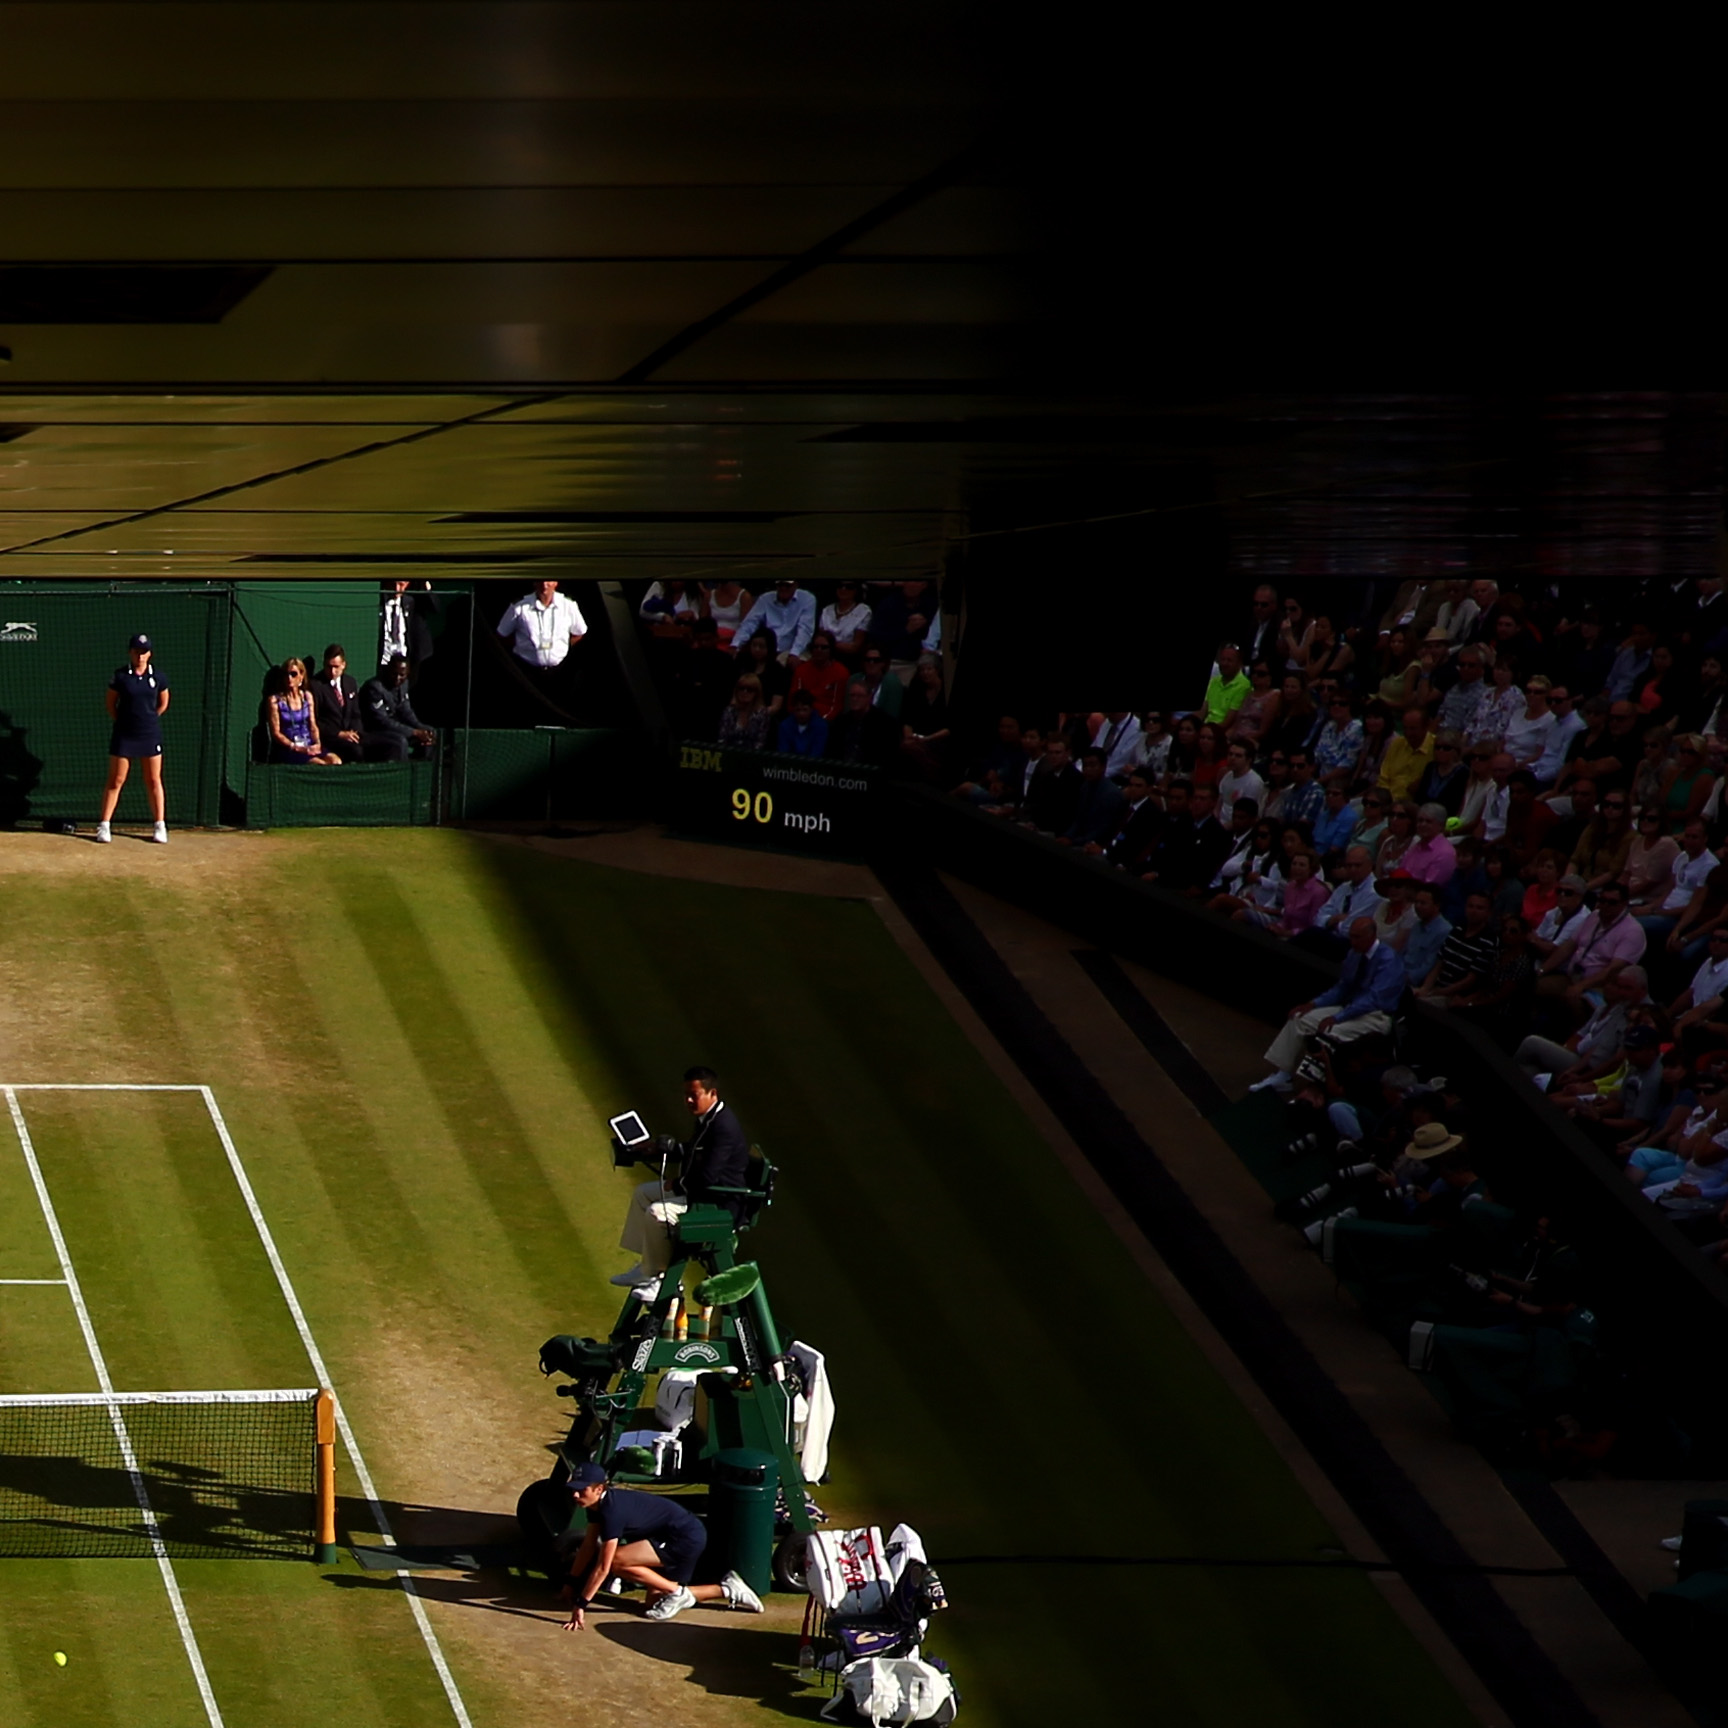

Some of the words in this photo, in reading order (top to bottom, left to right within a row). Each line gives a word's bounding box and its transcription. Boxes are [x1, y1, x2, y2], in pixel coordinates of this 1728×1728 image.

[680, 746, 722, 773] IBM
[762, 765, 868, 792] wimbledon.com
[731, 787, 773, 824] 90
[784, 811, 831, 833] mph
